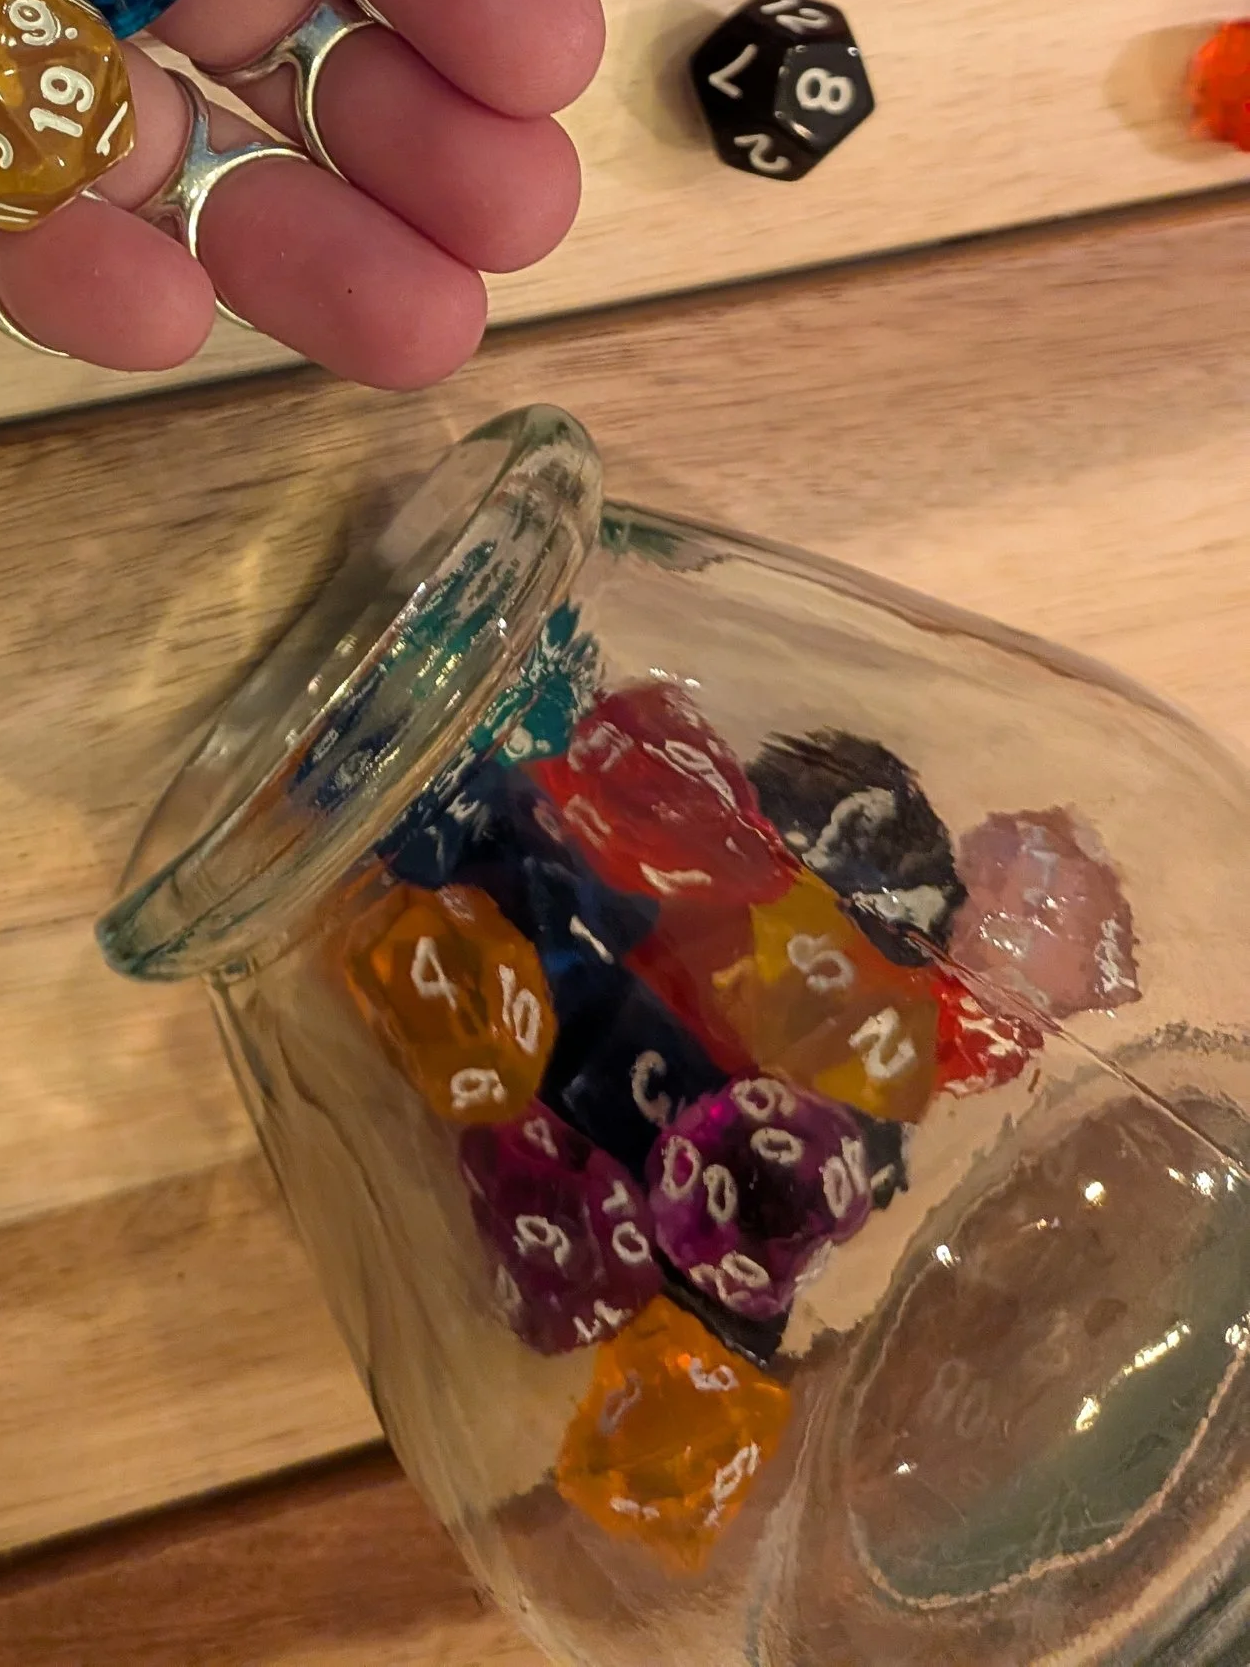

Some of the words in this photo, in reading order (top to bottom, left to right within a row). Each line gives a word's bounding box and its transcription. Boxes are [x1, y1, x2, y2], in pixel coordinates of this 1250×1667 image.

[708, 43, 758, 99] 7
[796, 67, 855, 115] 8
[30, 66, 95, 138] 19
[96, 101, 128, 156] 1
[734, 133, 792, 173] 2
[411, 936, 458, 1011] 4
[661, 1135, 739, 1227] 00
